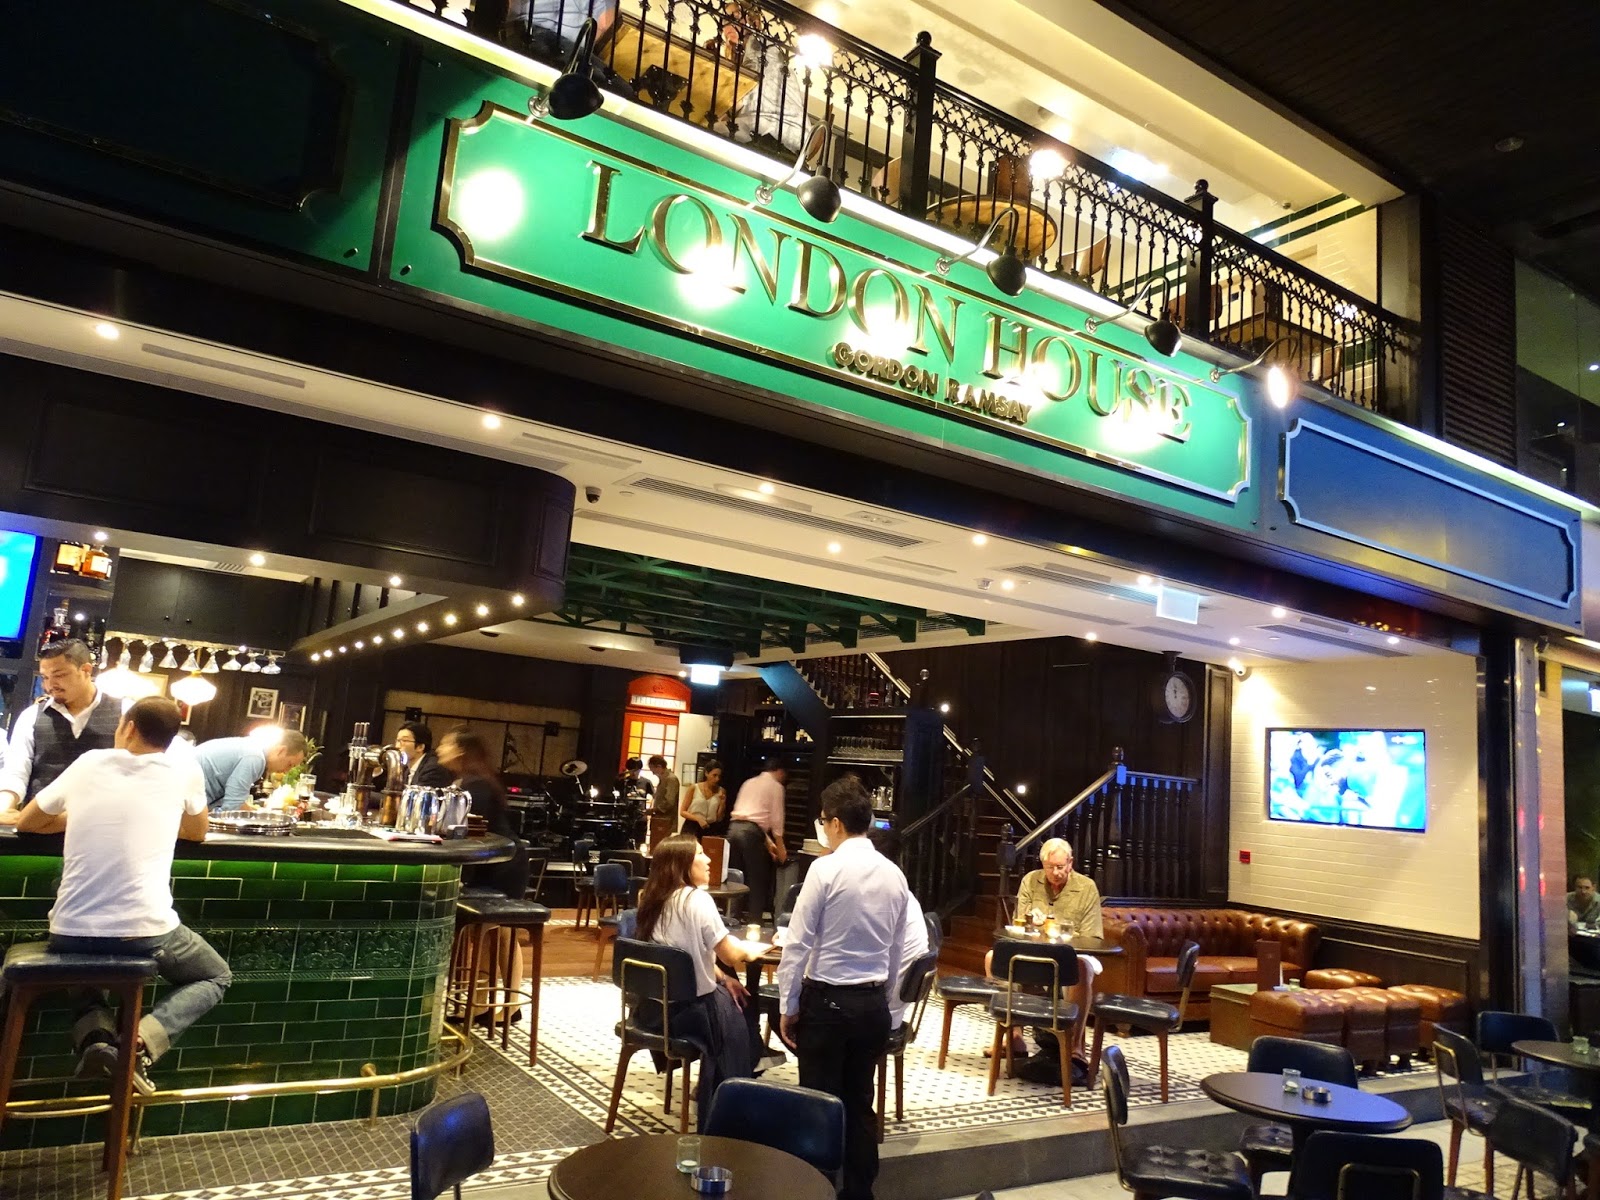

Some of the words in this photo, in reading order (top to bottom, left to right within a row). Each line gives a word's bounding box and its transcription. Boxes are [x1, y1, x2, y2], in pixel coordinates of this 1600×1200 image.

[577, 160, 966, 365] LONDON
[978, 310, 1192, 443] HOUSE
[832, 341, 939, 396] GORDON
[945, 378, 1032, 425] RAMSAY
